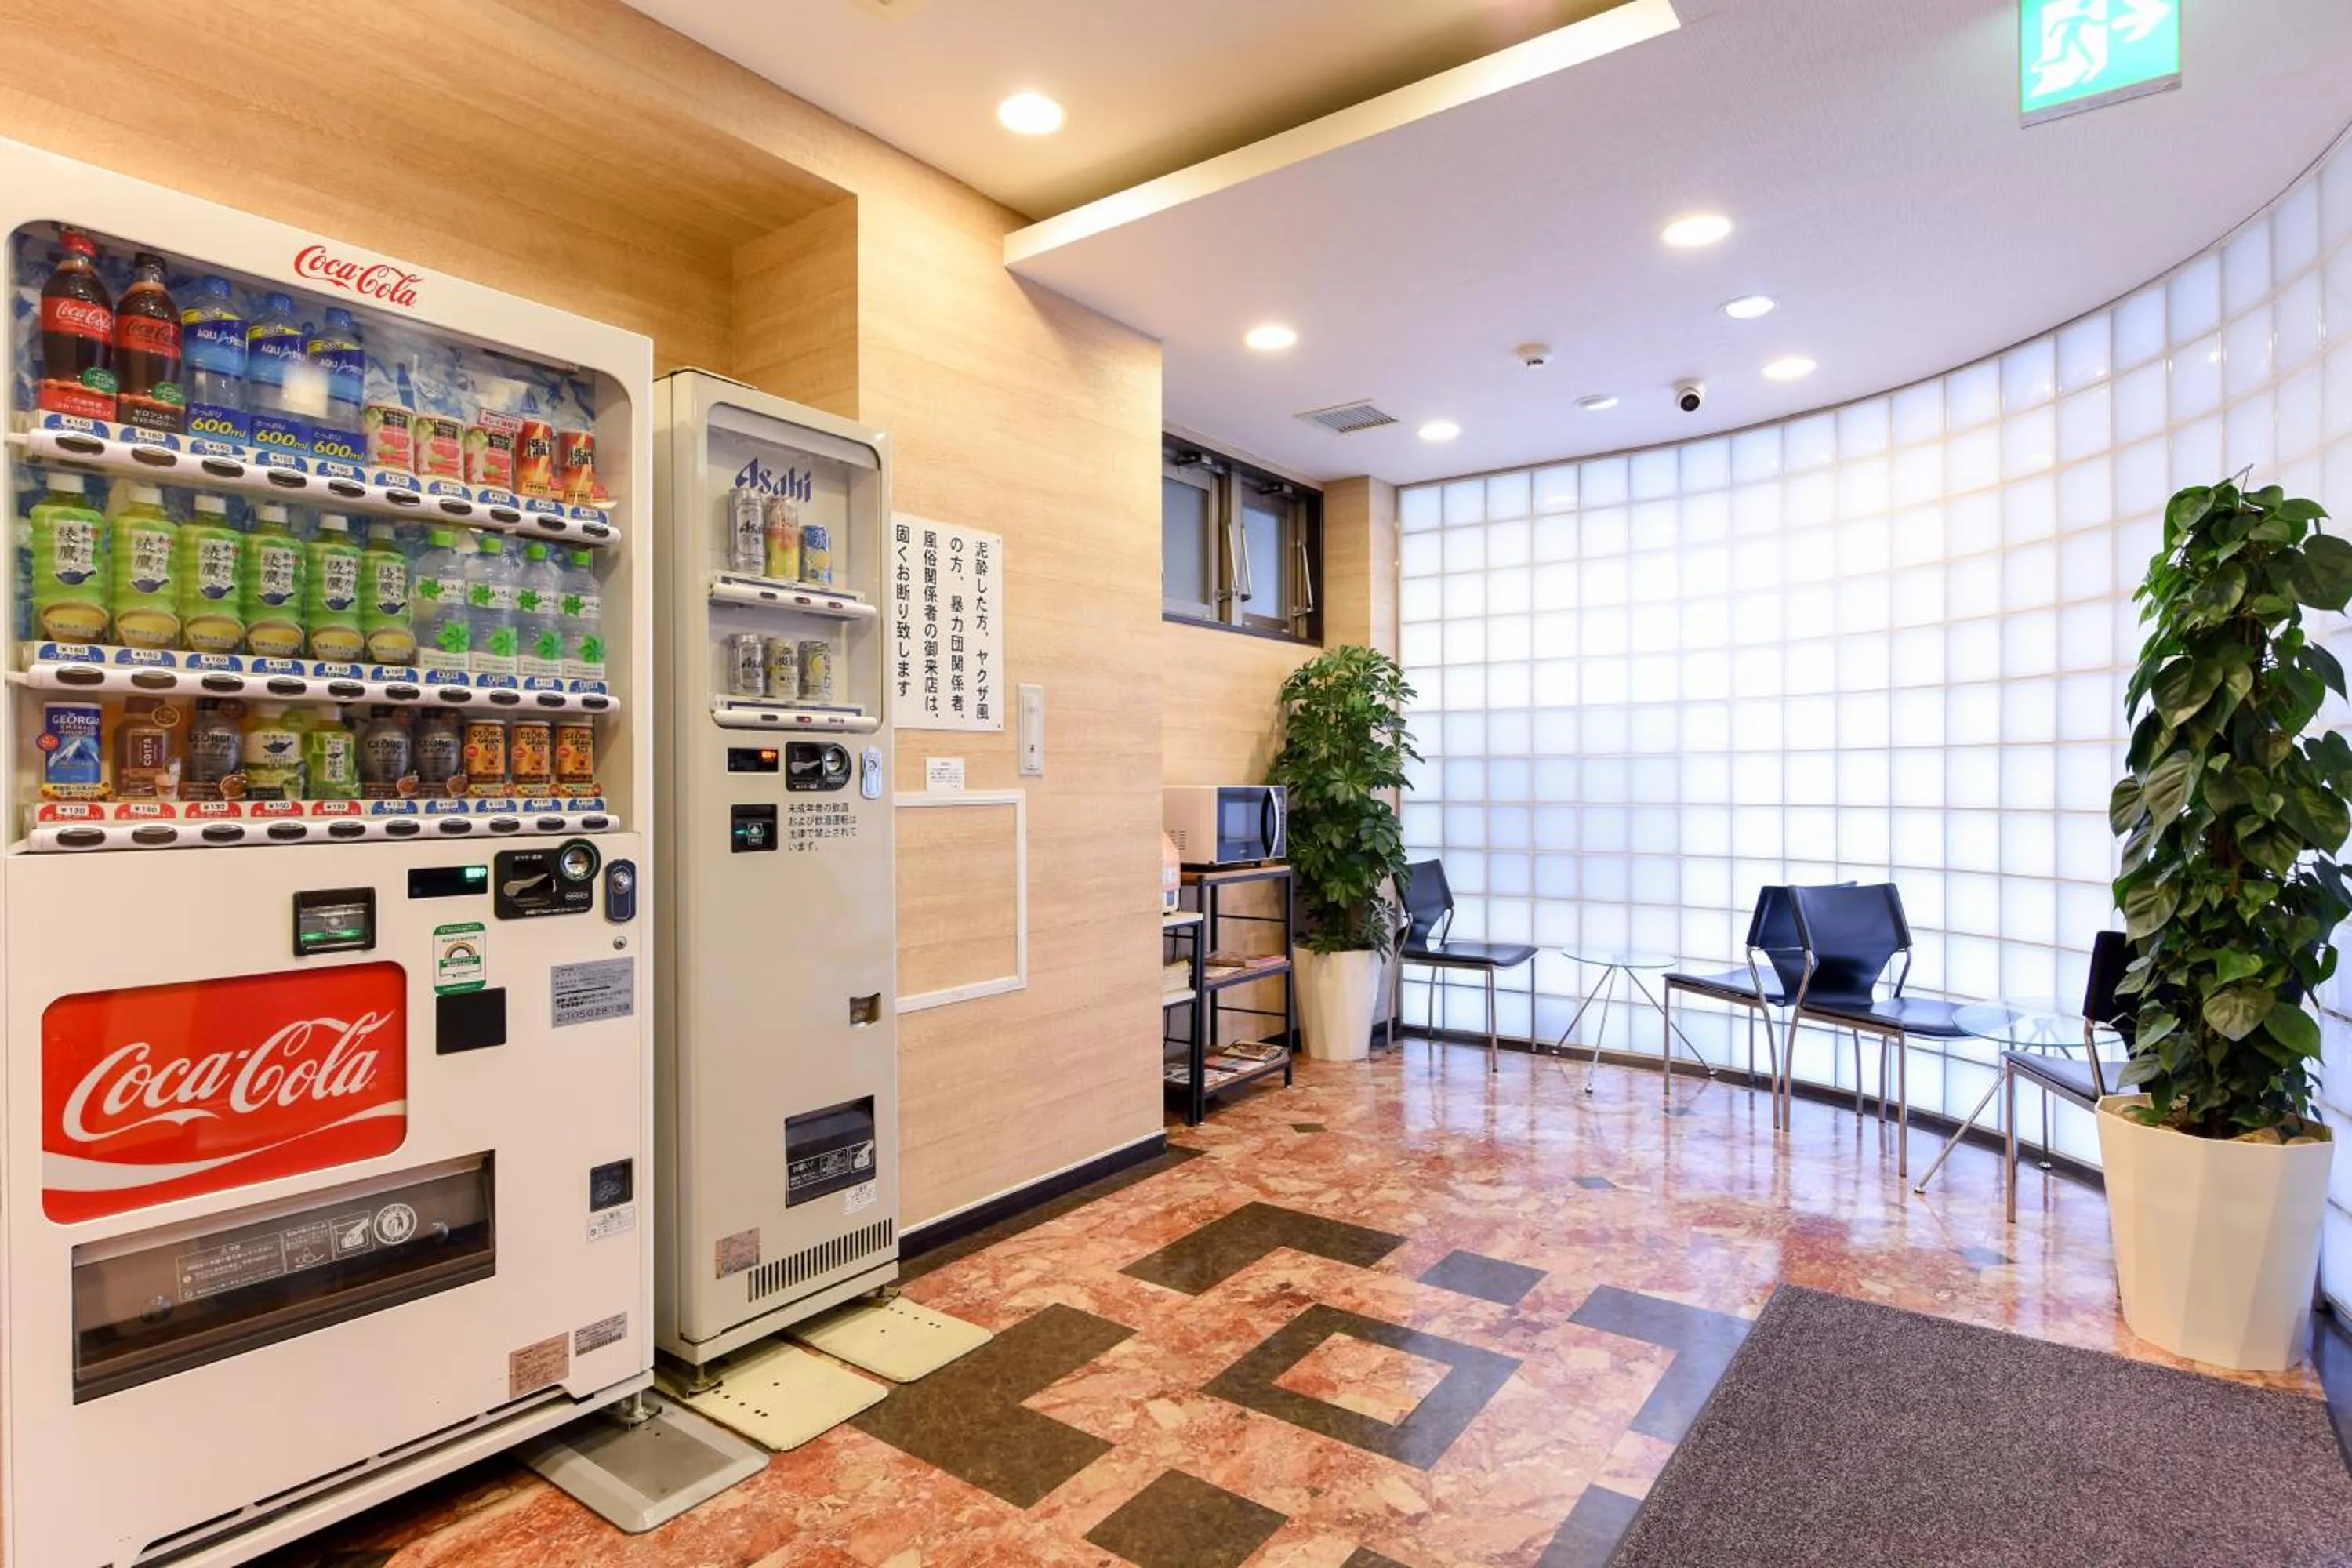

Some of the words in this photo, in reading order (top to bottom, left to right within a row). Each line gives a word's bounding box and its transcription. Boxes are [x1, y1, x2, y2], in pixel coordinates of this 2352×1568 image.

[294, 245, 424, 307] Coca-Cola
[191, 417, 248, 439] 600ml
[256, 430, 309, 451] 600ml
[313, 440, 365, 461] 600ml
[735, 456, 811, 503] Asahi
[895, 524, 911, 698] 固くお断り致します
[143, 737, 154, 767] COSTA
[787, 802, 850, 814] 未成年者の飲酒
[61, 1008, 397, 1143] Coca-Cola
